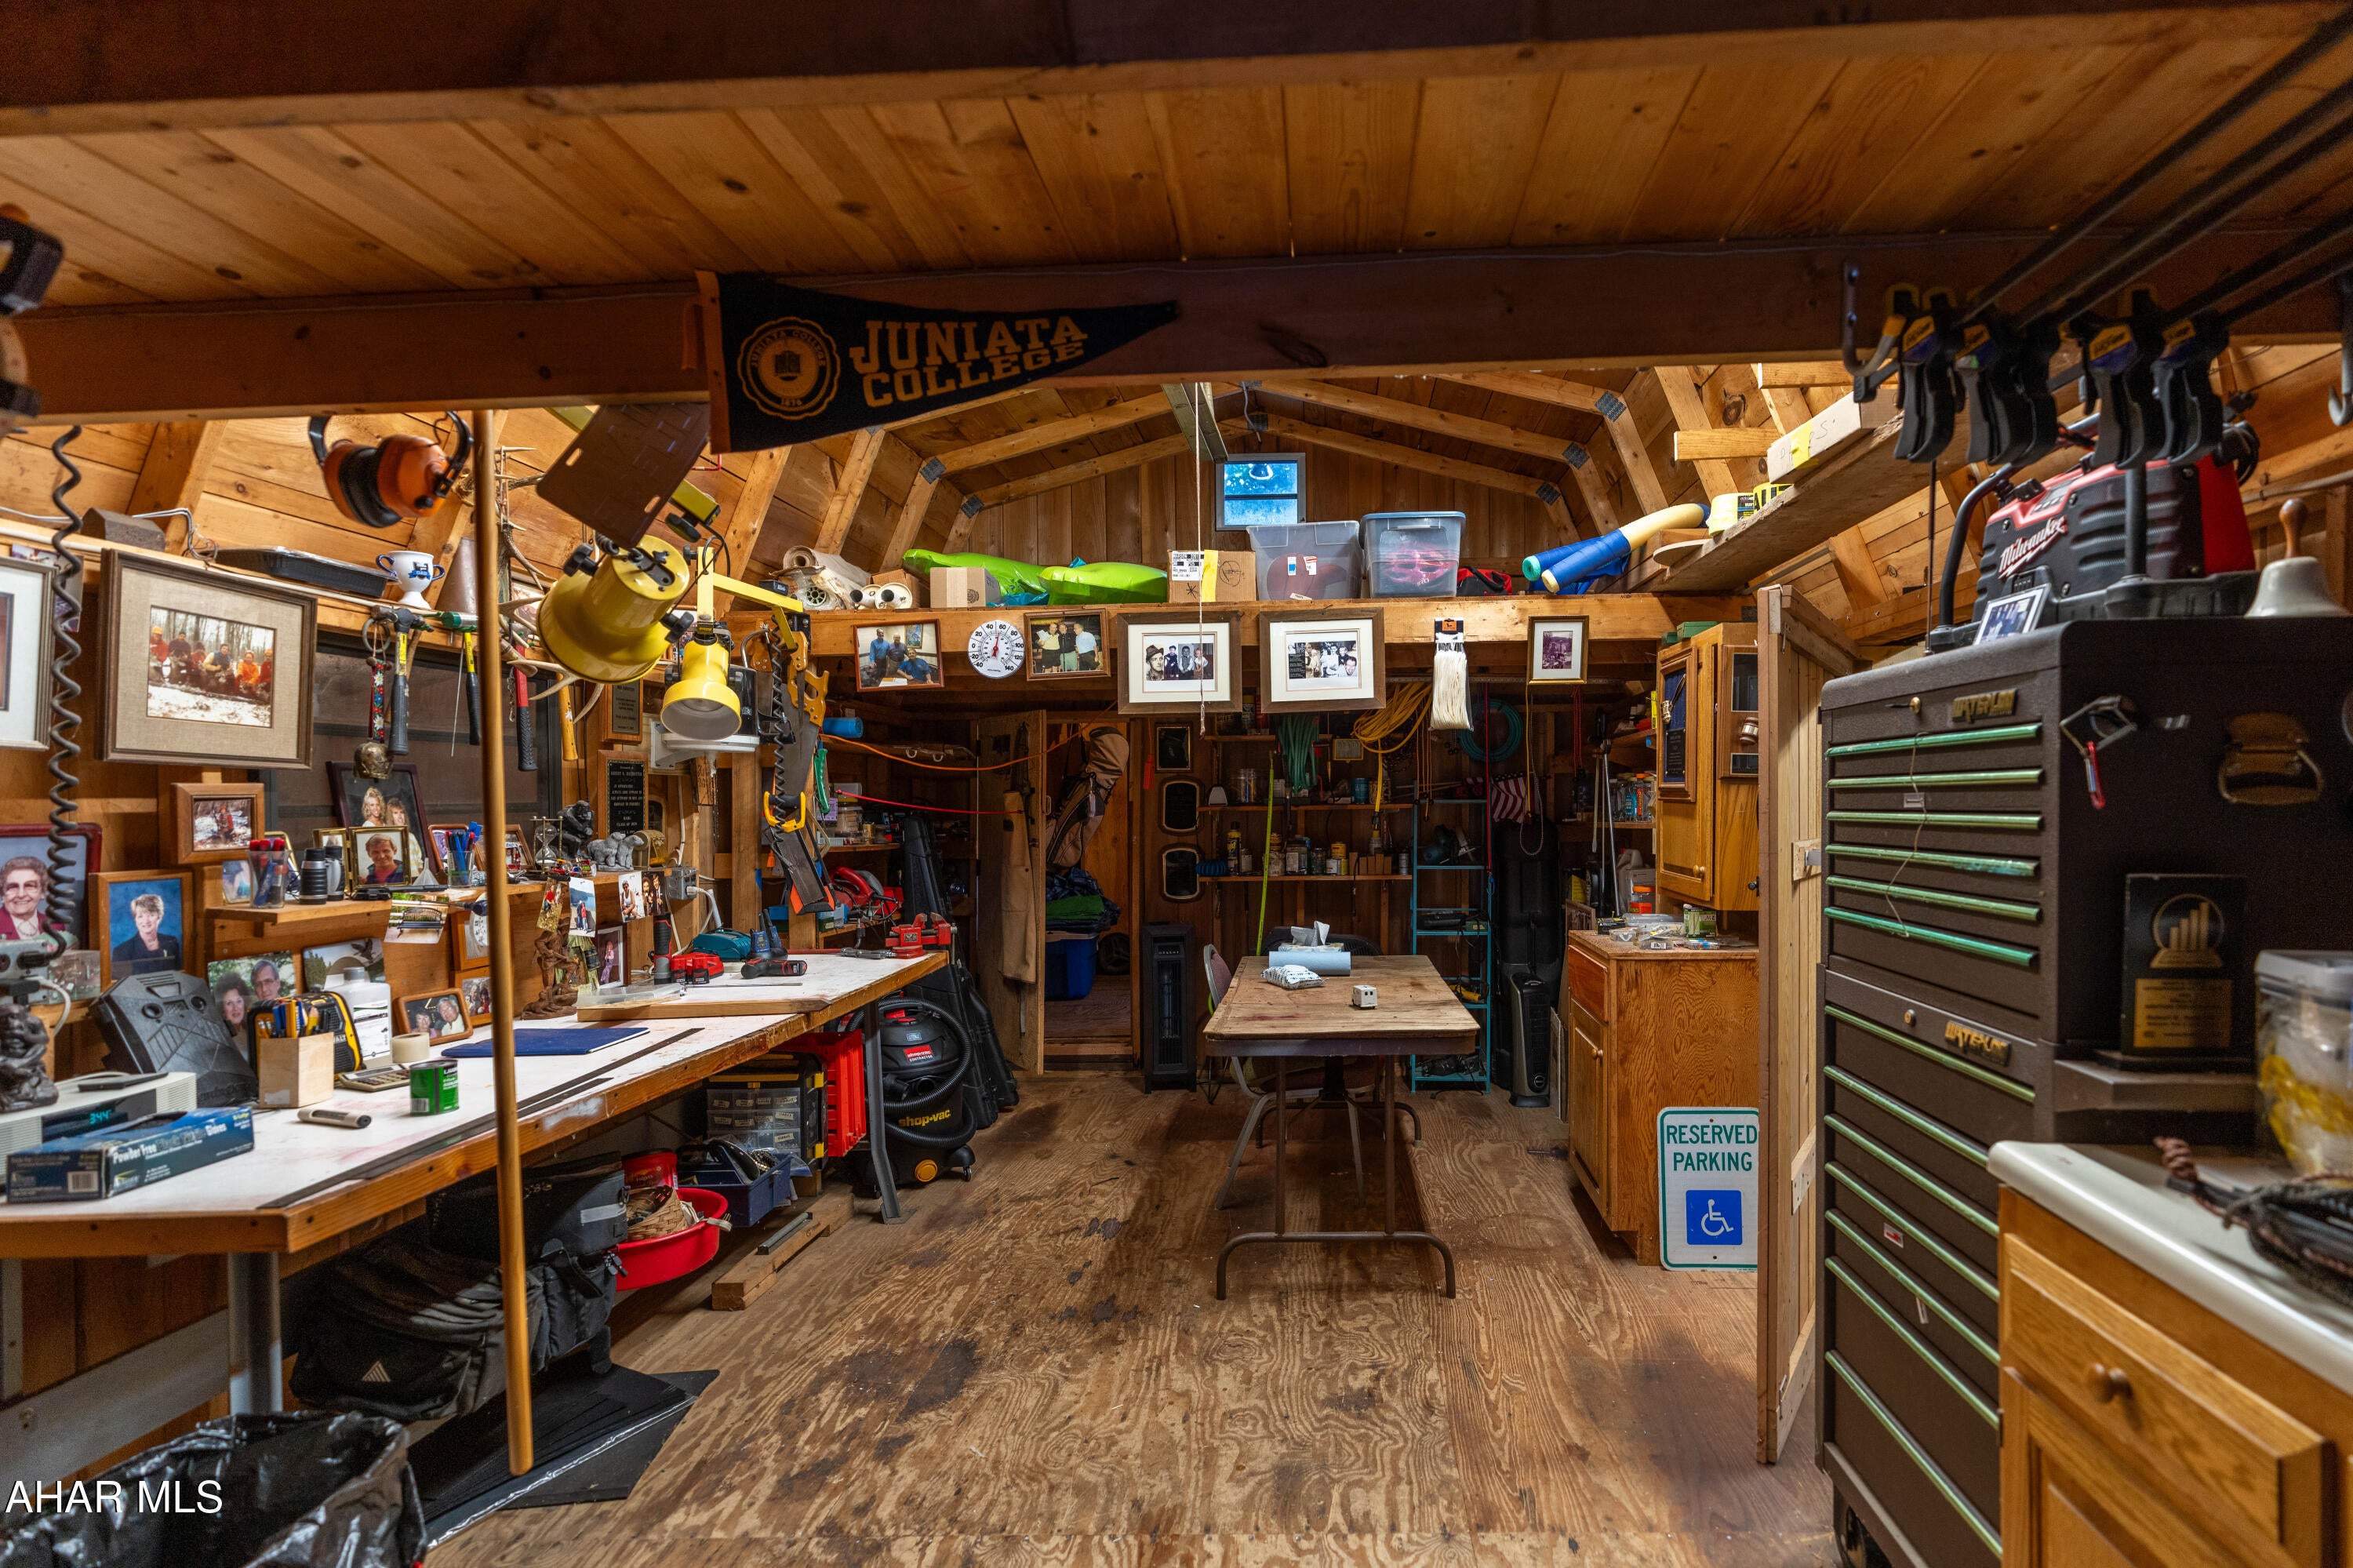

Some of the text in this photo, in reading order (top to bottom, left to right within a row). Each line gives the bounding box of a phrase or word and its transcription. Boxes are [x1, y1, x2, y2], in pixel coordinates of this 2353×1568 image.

[751, 329, 787, 368] JUNIATA
[849, 315, 1089, 375] JUNIATA
[863, 341, 1085, 408] COLLEGE
[1998, 515, 2069, 574] Milwaukee
[112, 1146, 143, 1164] Powder
[141, 1143, 156, 1157] Free
[205, 1122, 227, 1137] Gloves
[1666, 1124, 1758, 1144] RESERVED
[1673, 1151, 1752, 1172] PARKING
